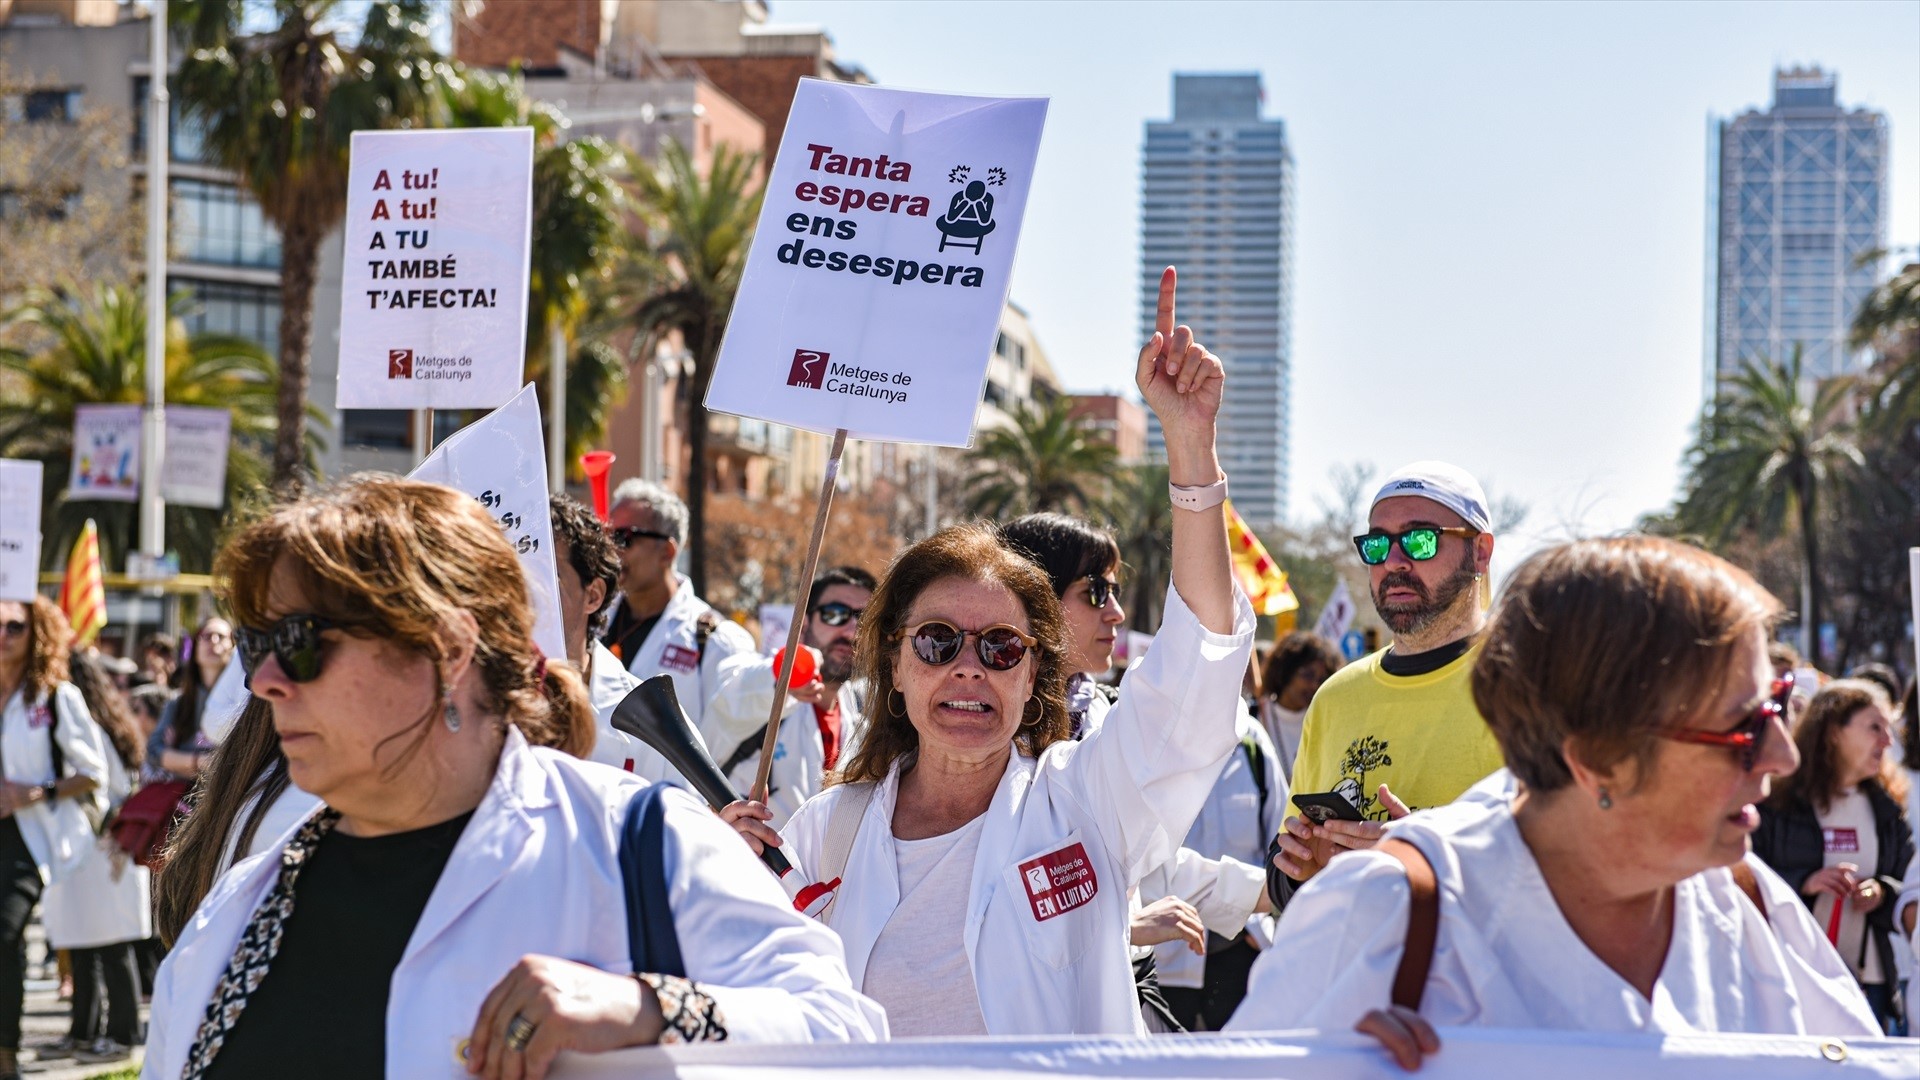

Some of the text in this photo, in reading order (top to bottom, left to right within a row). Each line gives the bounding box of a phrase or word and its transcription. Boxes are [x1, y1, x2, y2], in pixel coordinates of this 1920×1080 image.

[806, 143, 912, 183] Tanta
[372, 168, 438, 191] A tu!
[371, 197, 437, 220] A tu!
[794, 181, 931, 218] espera
[786, 212, 858, 241] ens
[369, 230, 429, 250] A TU
[368, 253, 457, 279] TAMBÉ
[776, 238, 985, 288] desespera
[415, 356, 472, 369] Metges de
[830, 362, 912, 386] Metges de
[415, 368, 472, 382] Catalunya
[826, 378, 908, 404] Catalunya
[1049, 858, 1083, 876] Metges de
[1054, 868, 1088, 886] Catalunya
[1036, 880, 1095, 918] EN LLUITA!!
